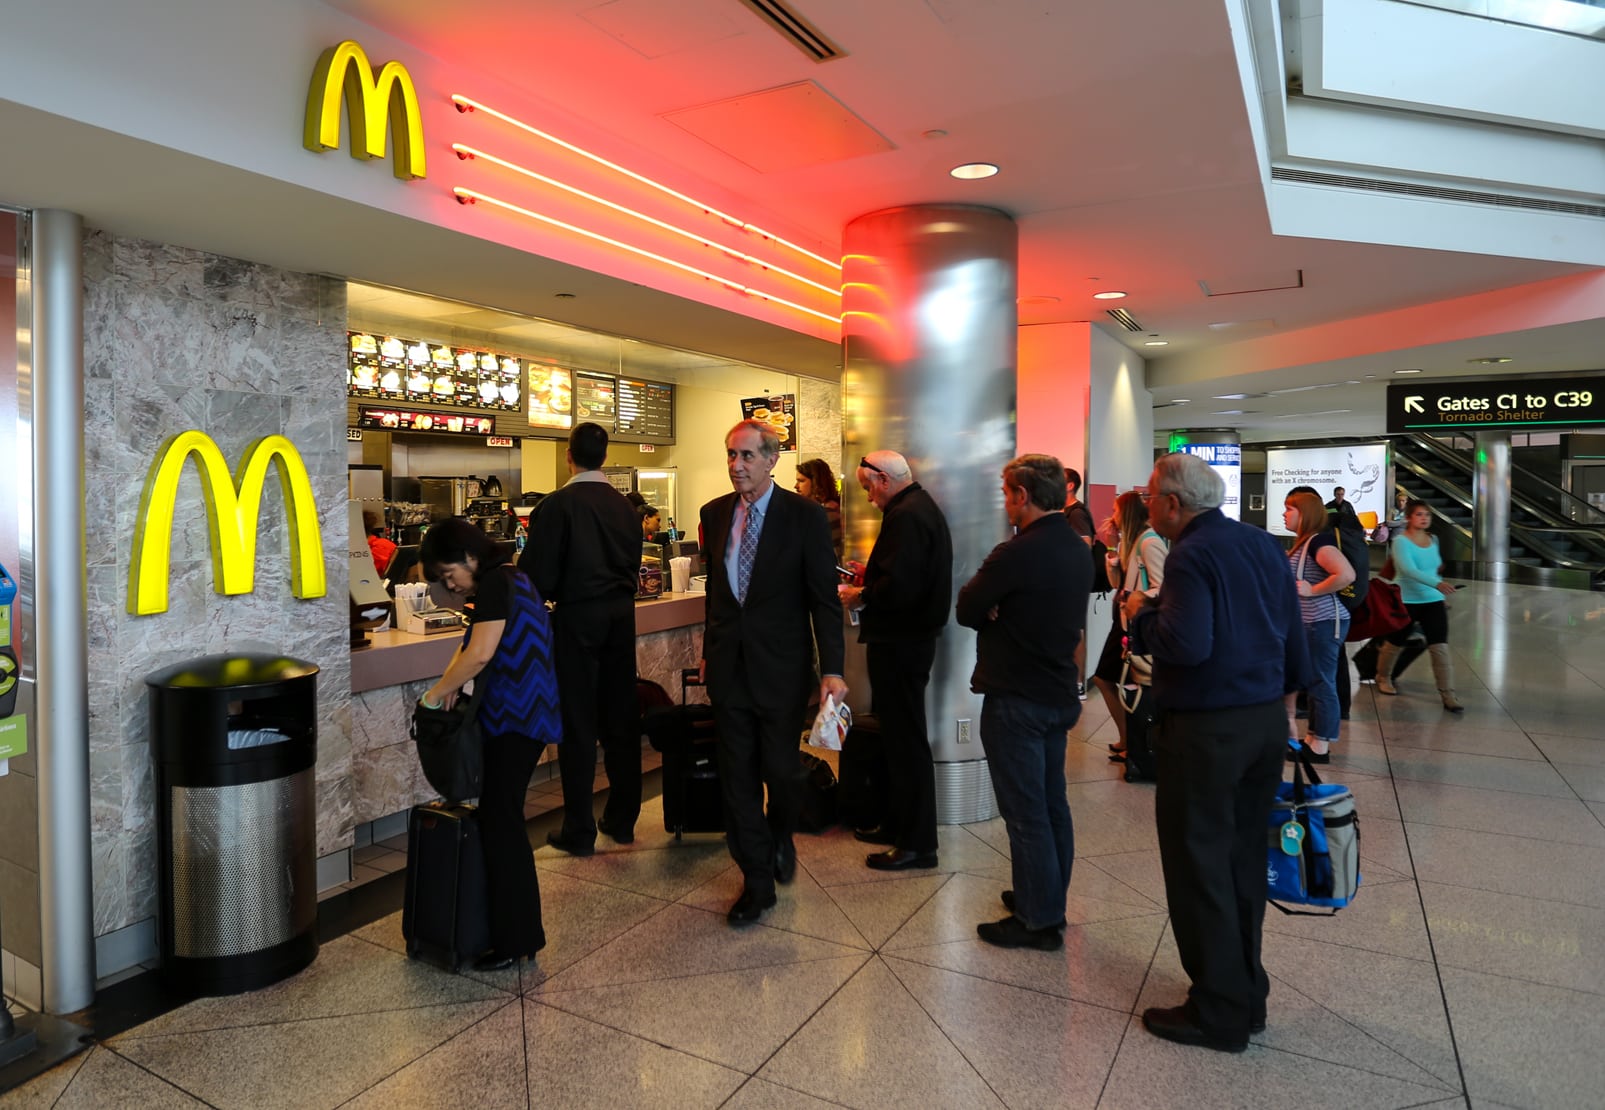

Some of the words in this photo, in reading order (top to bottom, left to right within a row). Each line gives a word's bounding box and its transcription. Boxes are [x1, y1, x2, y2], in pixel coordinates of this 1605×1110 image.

[1437, 396, 1490, 411] Gates
[1496, 394, 1517, 409] C1
[1525, 394, 1547, 408] to
[1553, 391, 1593, 407] C39
[1438, 411, 1493, 422] Tornado
[1496, 410, 1545, 421] Shelter
[490, 437, 511, 446] OPEN
[1190, 446, 1215, 461] MIN
